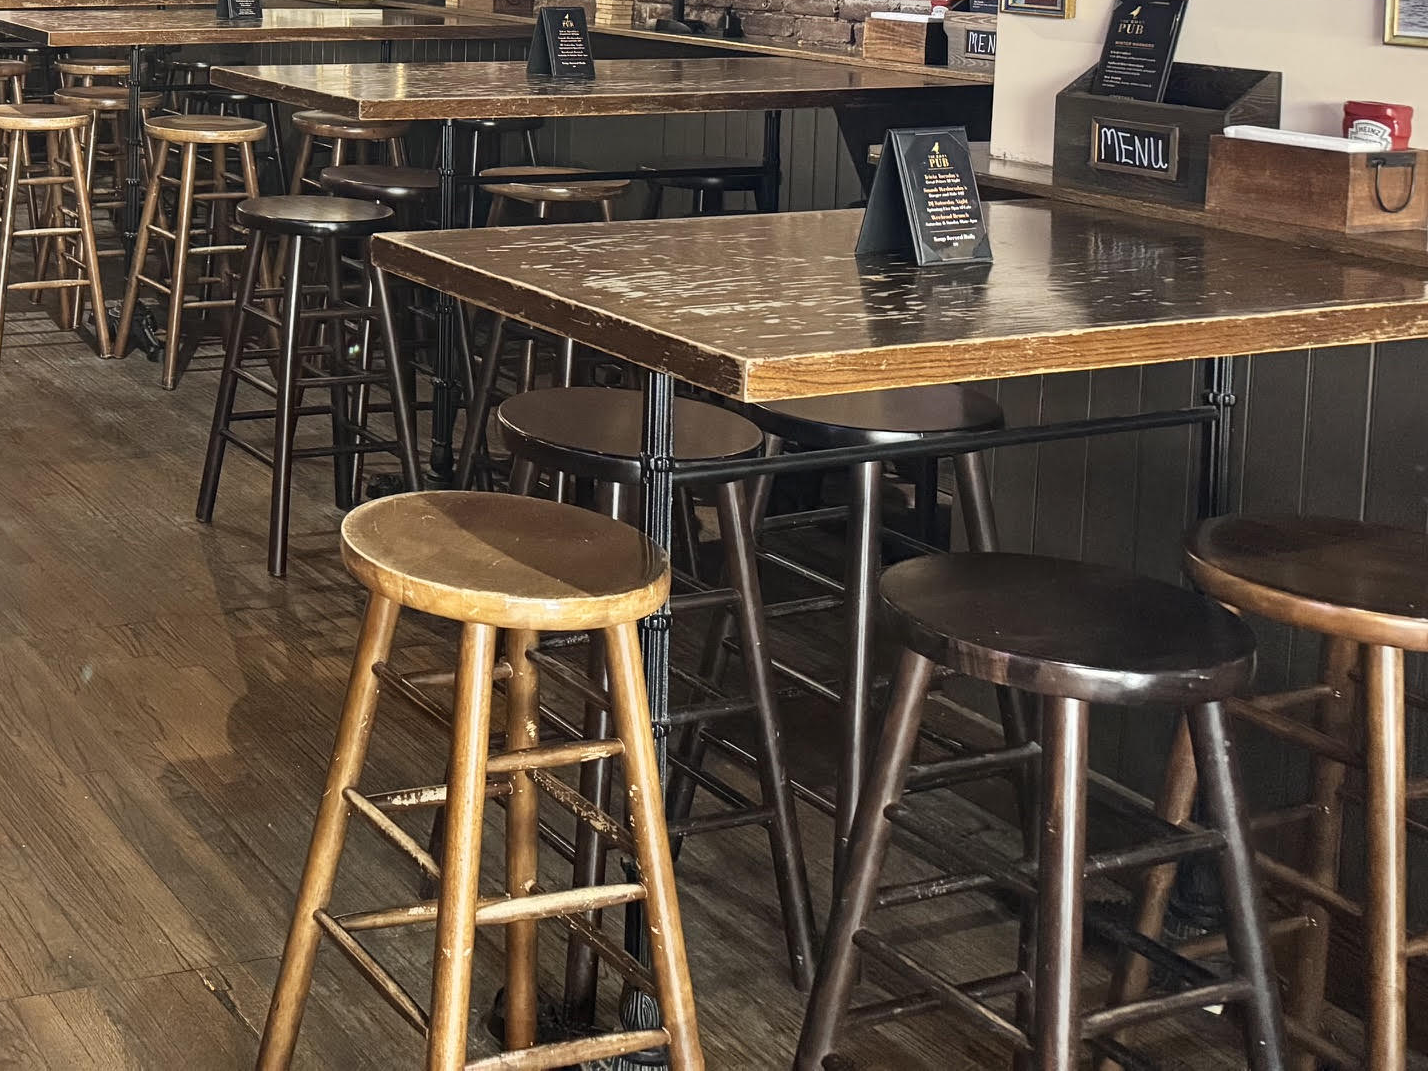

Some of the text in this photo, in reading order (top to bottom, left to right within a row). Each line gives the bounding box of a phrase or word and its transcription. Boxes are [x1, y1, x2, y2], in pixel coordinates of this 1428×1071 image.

[1118, 23, 1144, 35] PUB
[968, 31, 996, 54] MEN
[1358, 126, 1381, 136] HEINZ
[1101, 127, 1168, 169] MENU
[929, 158, 950, 167] PUB
